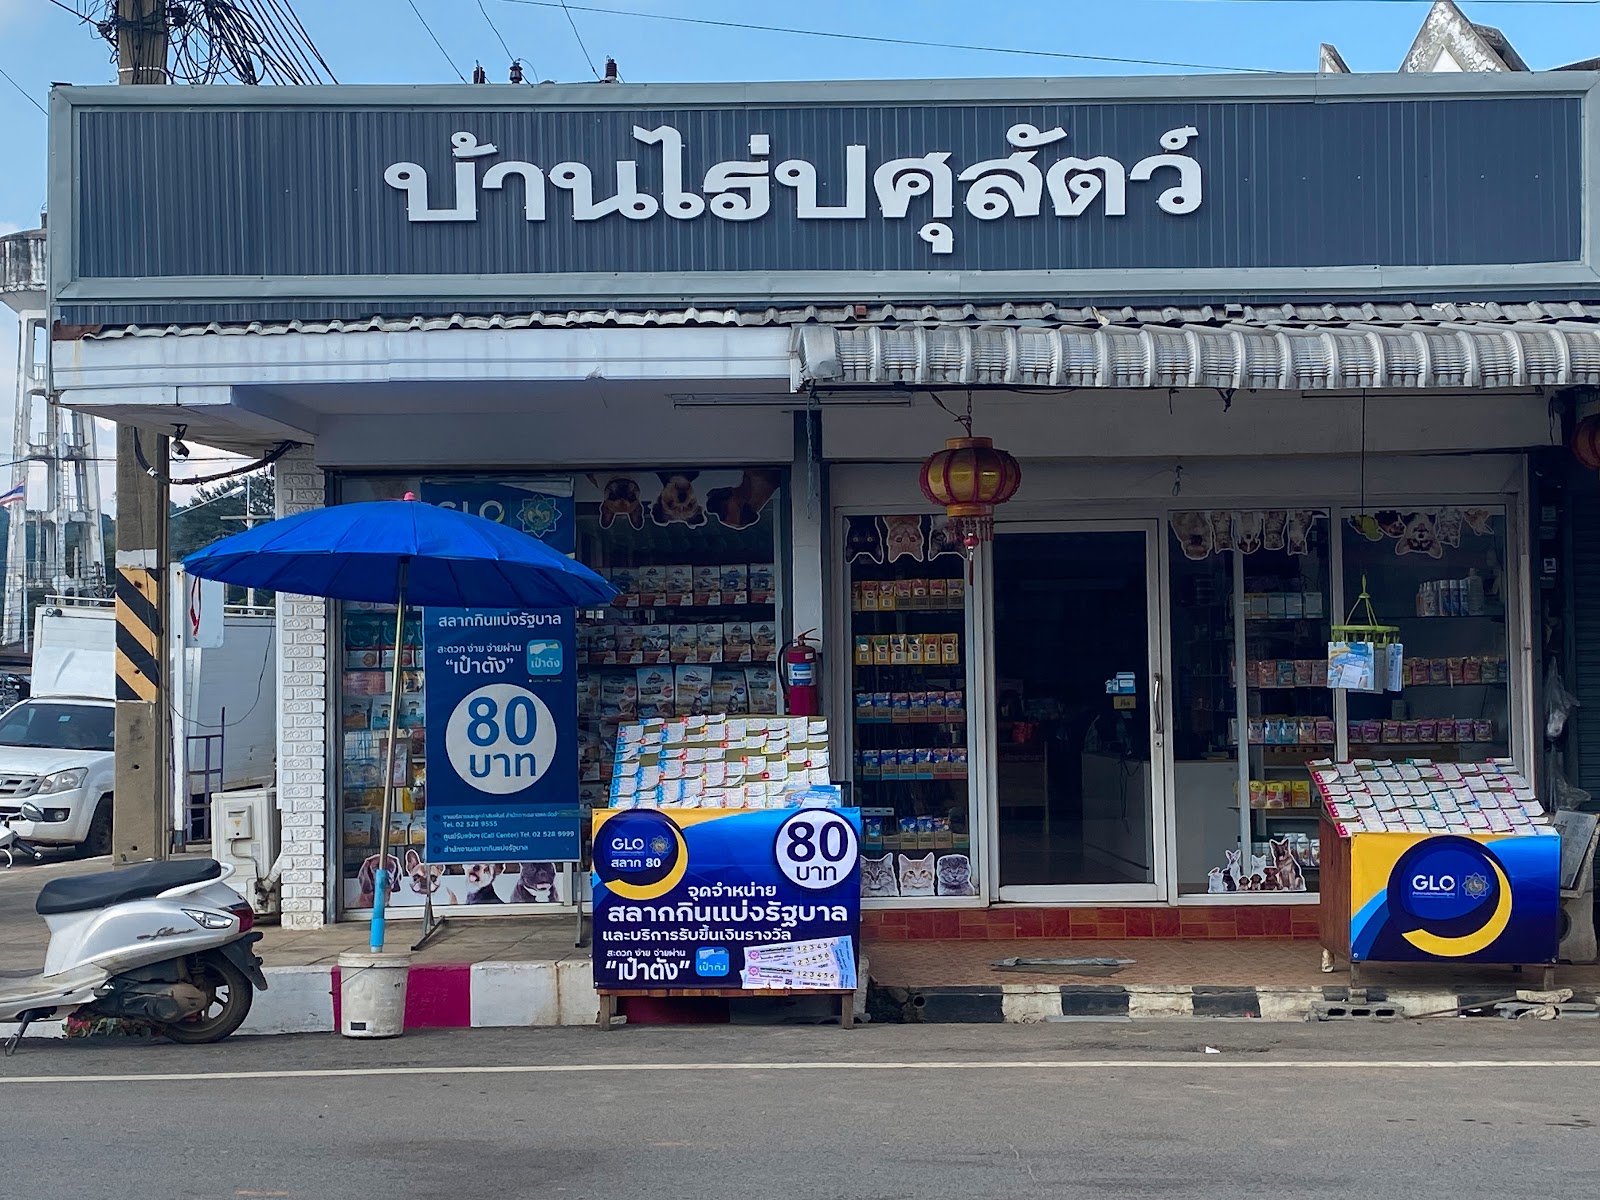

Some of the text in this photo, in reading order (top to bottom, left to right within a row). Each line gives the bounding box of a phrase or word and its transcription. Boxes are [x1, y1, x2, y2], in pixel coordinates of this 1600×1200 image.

[383, 123, 1202, 254] บ้านไร่ปศุสัตว์
[438, 612, 562, 628] สลากกินแบ่งรัฐบาล
[437, 645, 466, 654] สะดวก
[486, 642, 522, 653] จ่ายผ่าน
[467, 695, 537, 747] 80
[469, 752, 537, 778] บาท
[611, 838, 645, 850] GLO
[786, 821, 849, 862] 80
[611, 858, 661, 868] สลาก 80
[796, 866, 837, 881] บาท
[688, 881, 777, 901] จุดจำหน่าย
[1412, 875, 1456, 891] GLO
[608, 899, 848, 927] สลากกินแบ่งรัฐบาล
[602, 924, 792, 941] และบริการรับขึ้นเงินรางวัล
